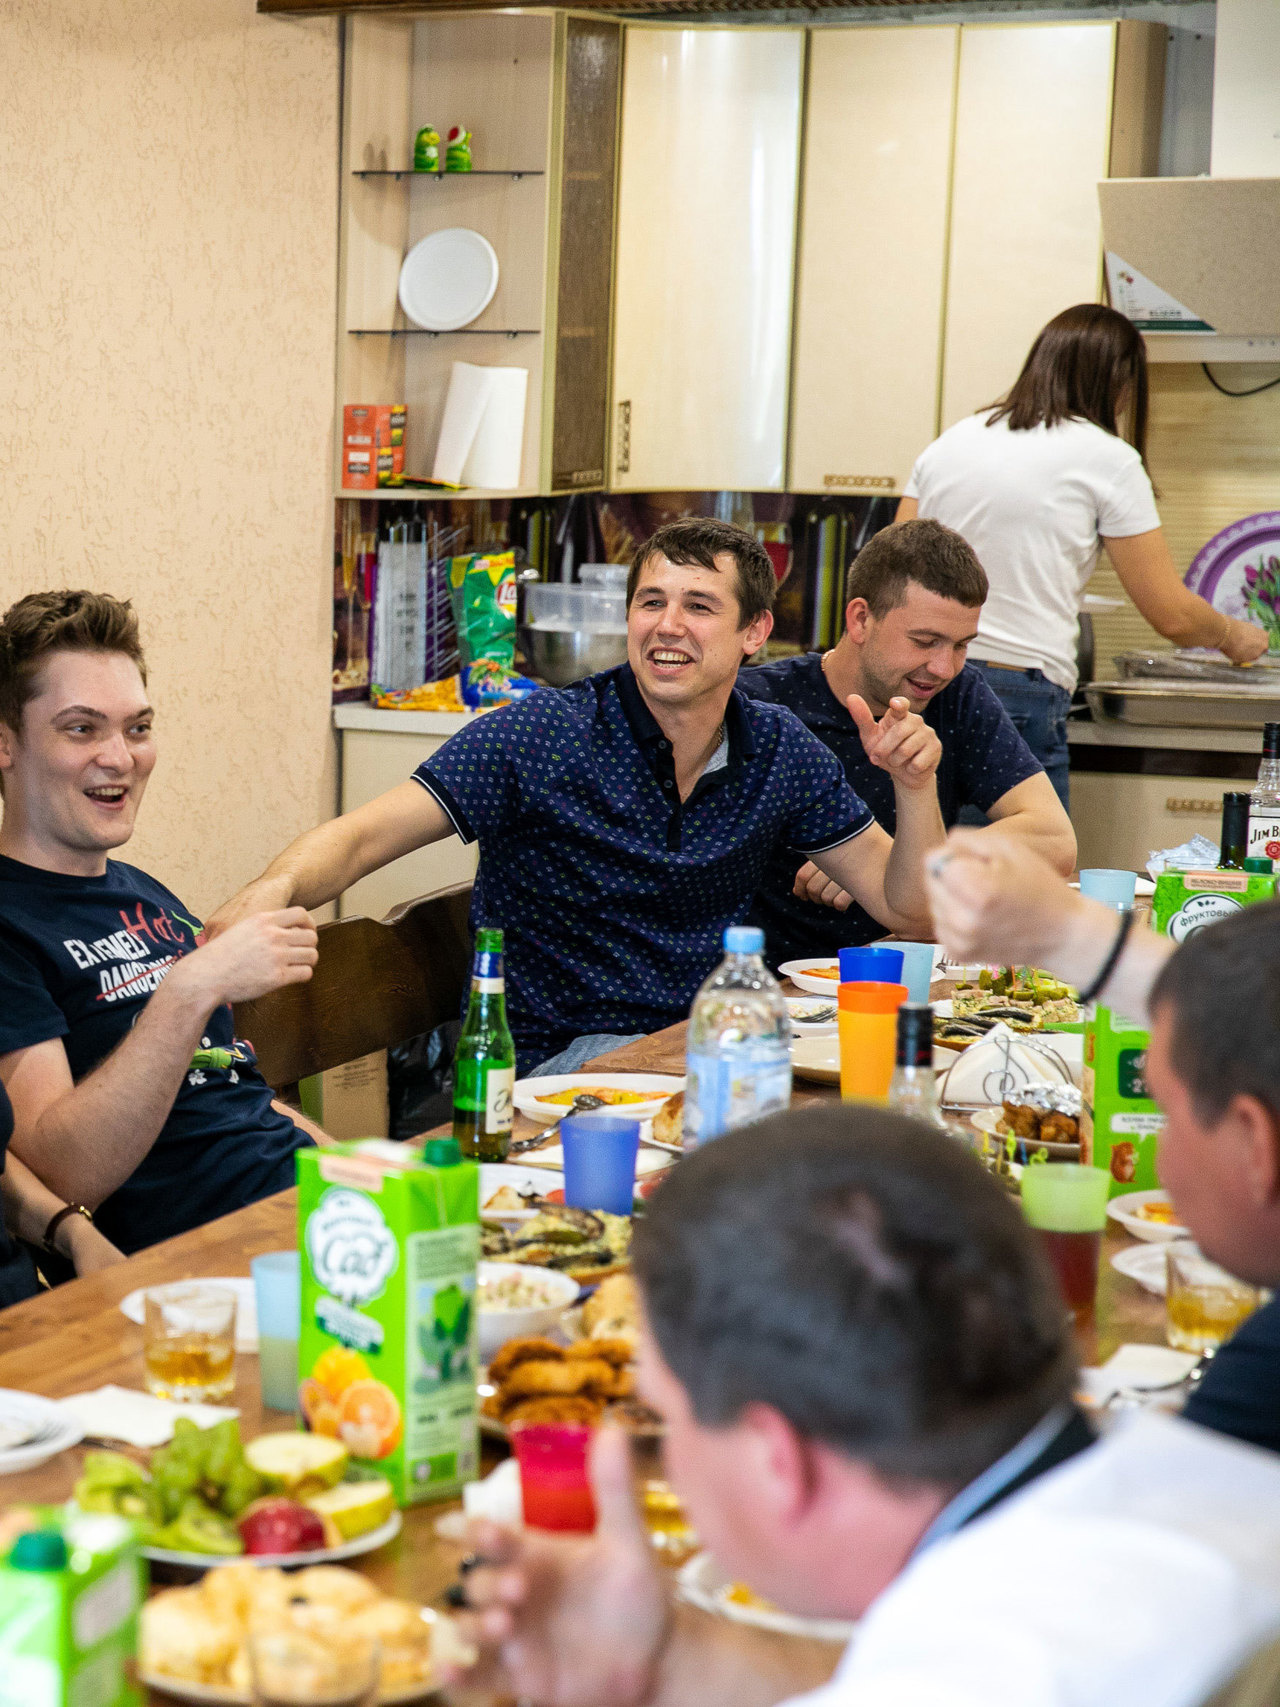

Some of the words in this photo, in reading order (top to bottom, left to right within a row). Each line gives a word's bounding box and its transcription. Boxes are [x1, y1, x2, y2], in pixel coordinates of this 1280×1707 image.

[1250, 829, 1270, 844] JIM
[1272, 825, 1280, 837] B
[119, 902, 184, 943] Hot
[1180, 909, 1239, 927] фруктовы
